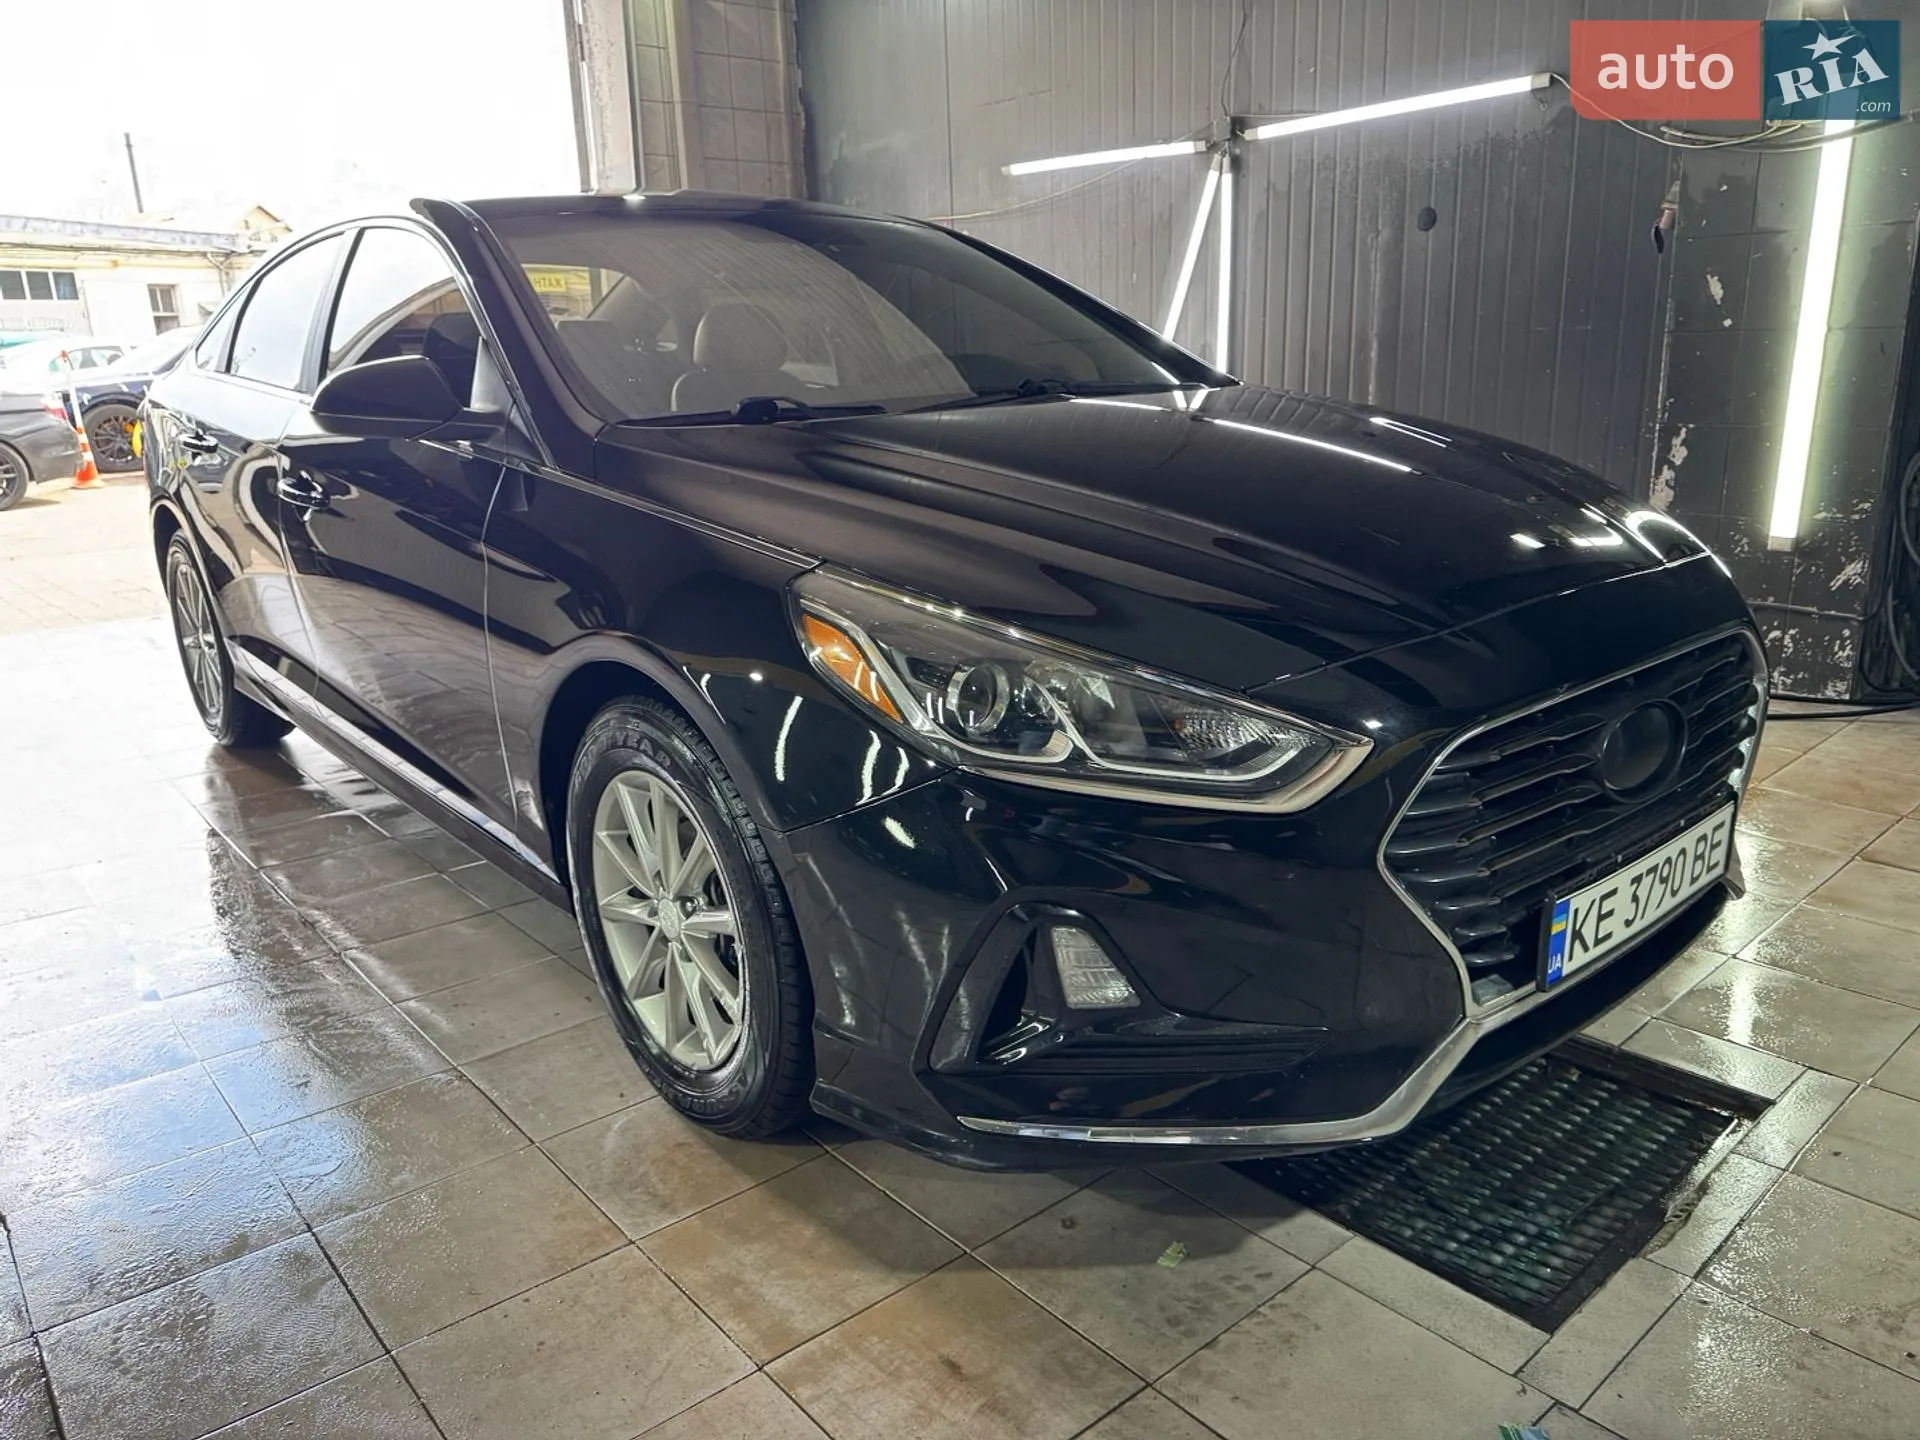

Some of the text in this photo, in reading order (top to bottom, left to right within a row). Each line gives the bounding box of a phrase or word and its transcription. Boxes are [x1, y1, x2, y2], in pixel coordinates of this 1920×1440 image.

[1568, 888, 1619, 962] KE
[1624, 846, 1687, 929] 3790
[1689, 820, 1726, 887] BE
